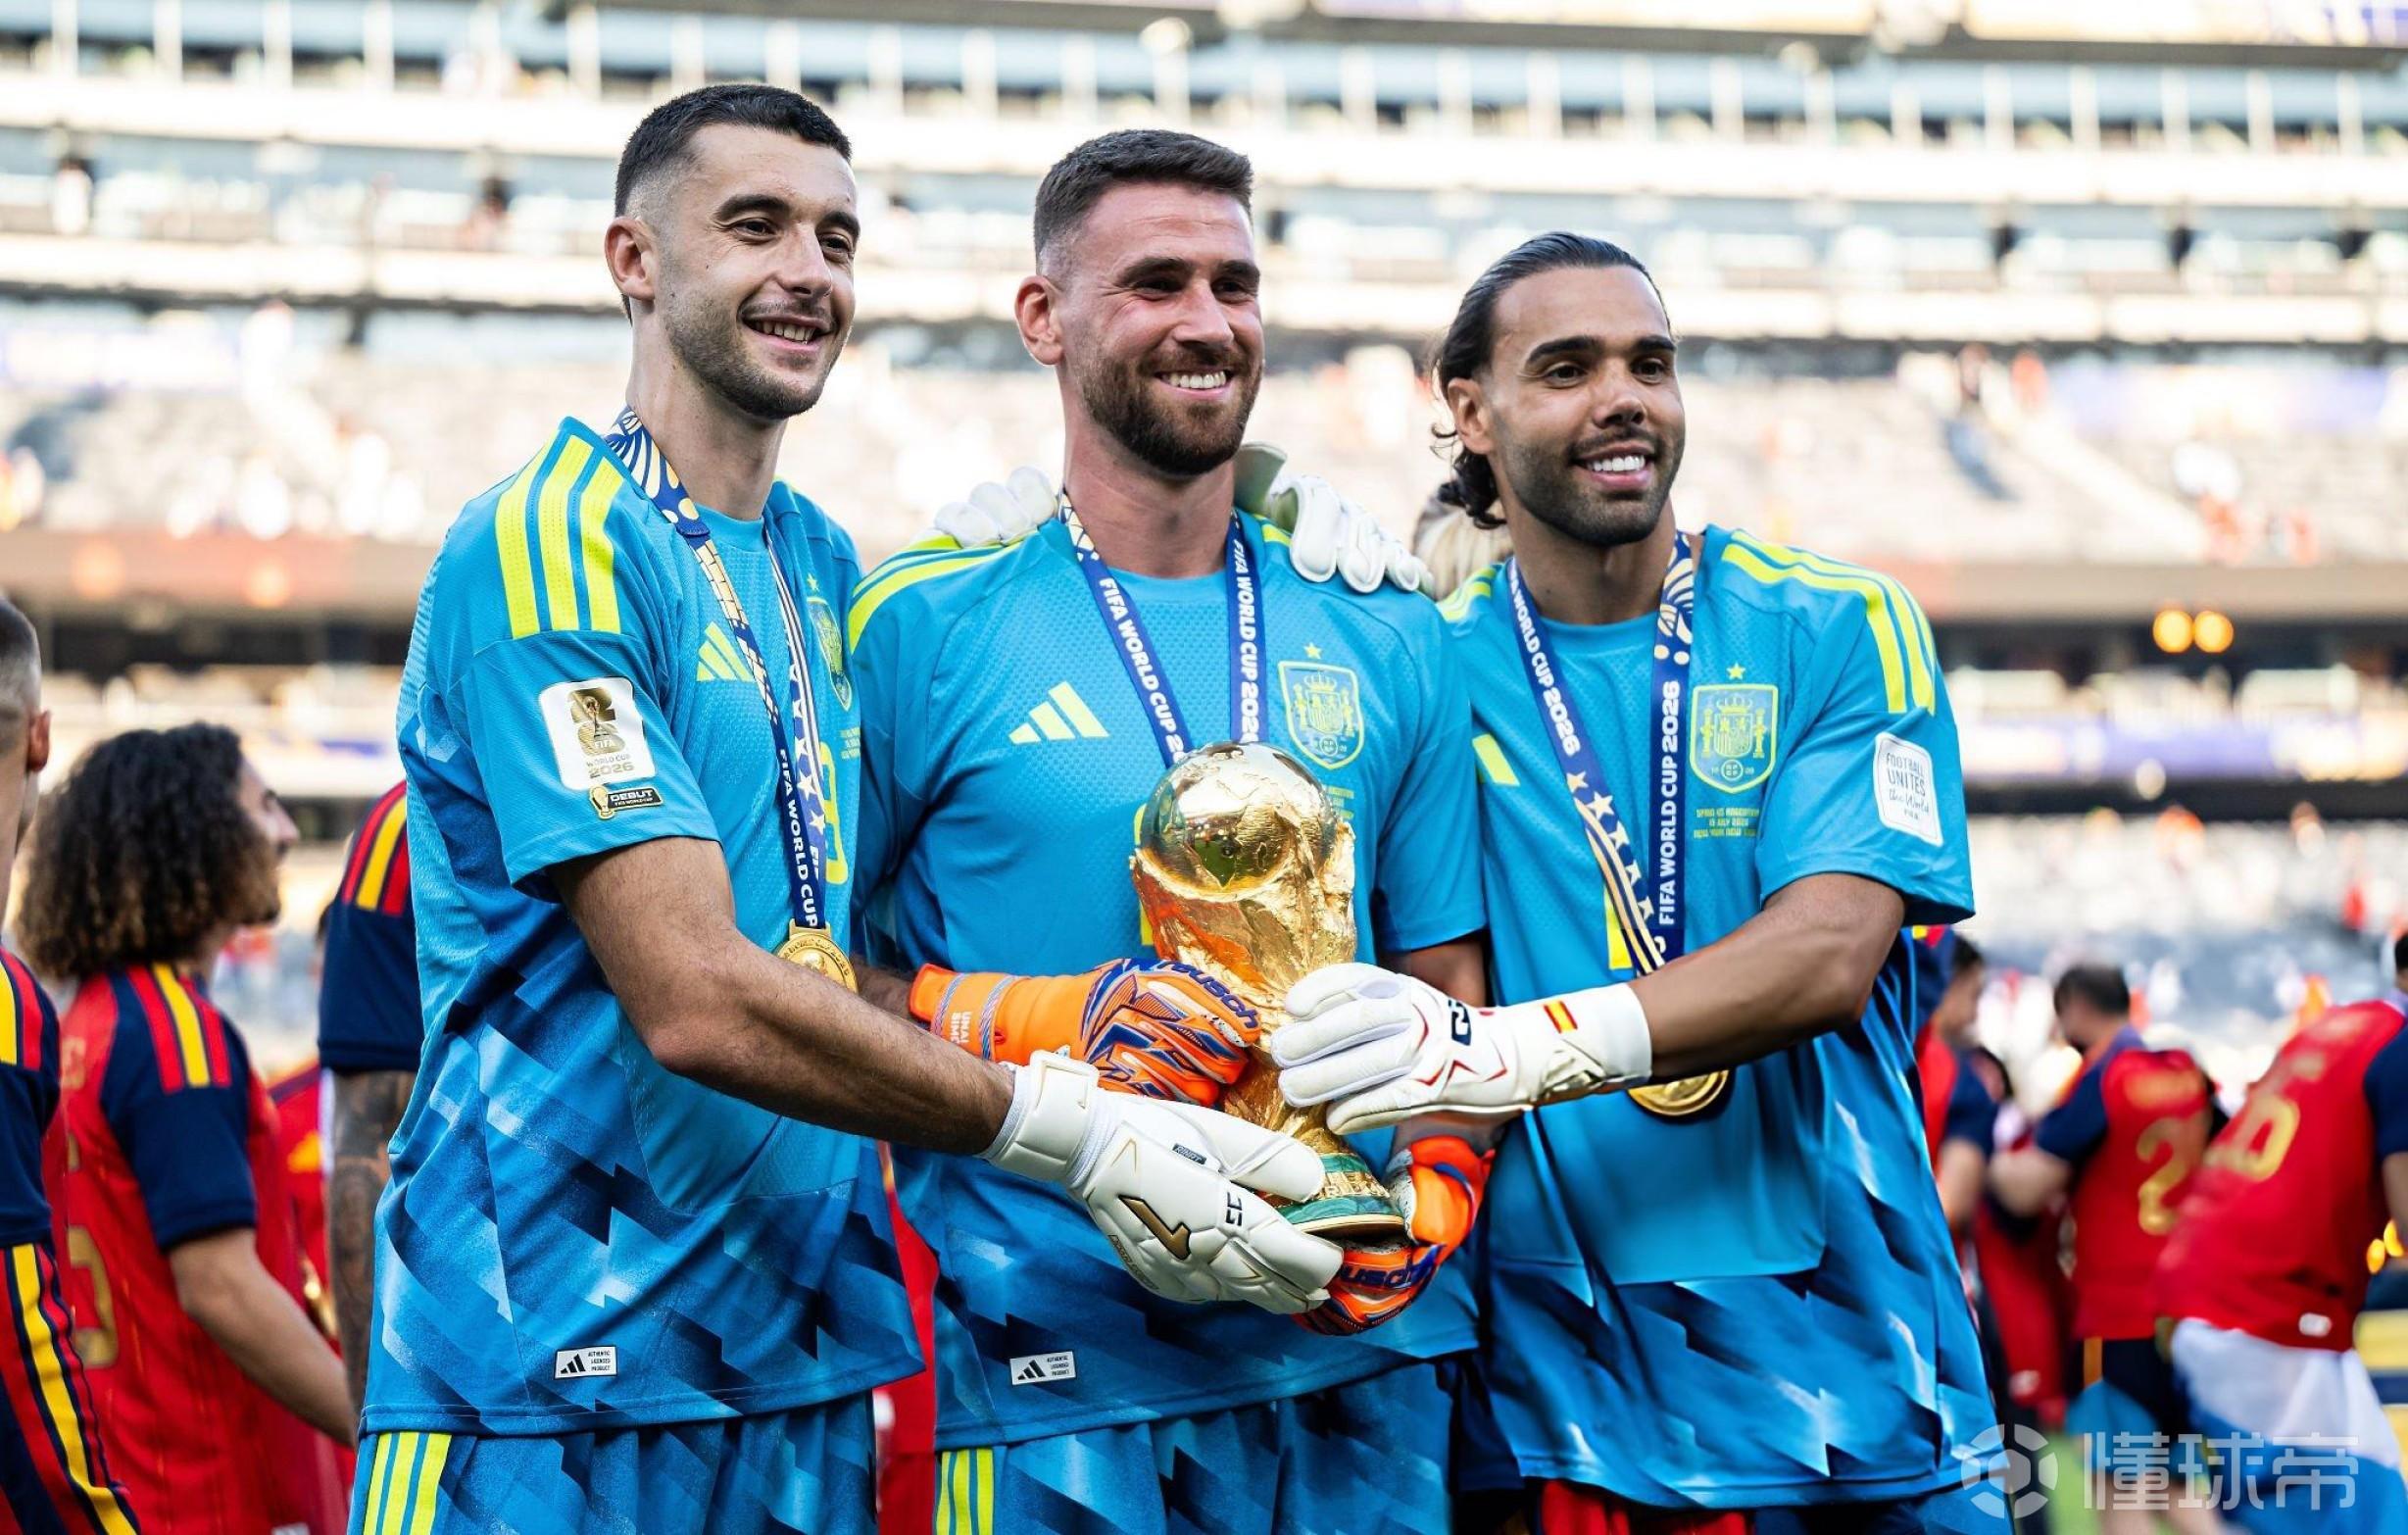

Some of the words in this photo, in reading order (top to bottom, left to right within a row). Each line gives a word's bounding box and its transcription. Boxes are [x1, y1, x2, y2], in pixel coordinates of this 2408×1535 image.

[1233, 539, 1249, 573] FIFA
[1236, 577, 1256, 641] WORLD
[1099, 578, 1128, 620] FIFA
[1117, 619, 1159, 690] WORLD
[1150, 692, 1177, 733] CUP
[1239, 642, 1258, 680] CUP
[1532, 652, 1554, 686] CUP
[1543, 686, 1581, 757] 2026
[1661, 680, 1681, 753] 2026
[588, 761, 634, 778] 2026
[1660, 756, 1679, 796] CUP
[1888, 769, 1926, 797] UNITES
[610, 789, 654, 802] DEBUT
[780, 749, 794, 797] FIFA
[787, 800, 809, 881] WORLD
[801, 884, 818, 927] CUP
[1659, 800, 1678, 877] WORLD
[1658, 879, 1676, 925] FIFA
